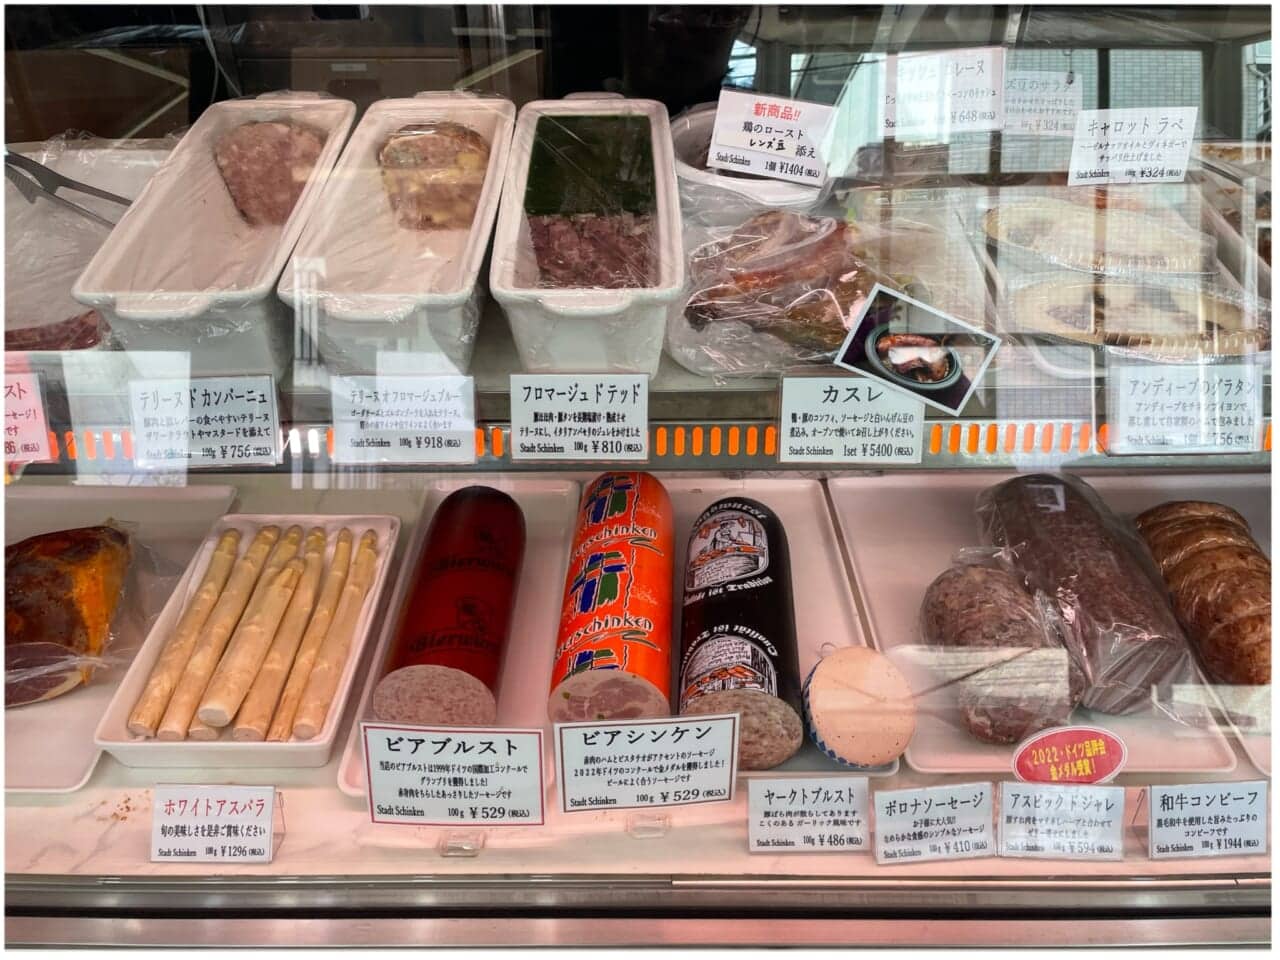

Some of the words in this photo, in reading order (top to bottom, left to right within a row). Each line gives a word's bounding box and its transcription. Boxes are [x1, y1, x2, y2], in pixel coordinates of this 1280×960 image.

[742, 120, 804, 141] 鶏のロースト
[522, 383, 589, 404] フロマージュ
[822, 385, 884, 404] カスレ
[582, 726, 713, 747] ビアシンケン
[386, 737, 518, 757] ビアブルスト
[570, 796, 587, 808] Stadt
[588, 795, 617, 807] Schinken
[636, 792, 654, 804] 100g
[763, 786, 855, 806] ヤークトブルスト
[885, 791, 984, 817] ボロナソーセージ
[1160, 790, 1259, 812] 和牛コンビーフ
[164, 797, 266, 817] ホワイトアスパラ
[377, 804, 394, 817] Stadt
[395, 805, 425, 817] Schinken
[448, 807, 465, 819] 100g
